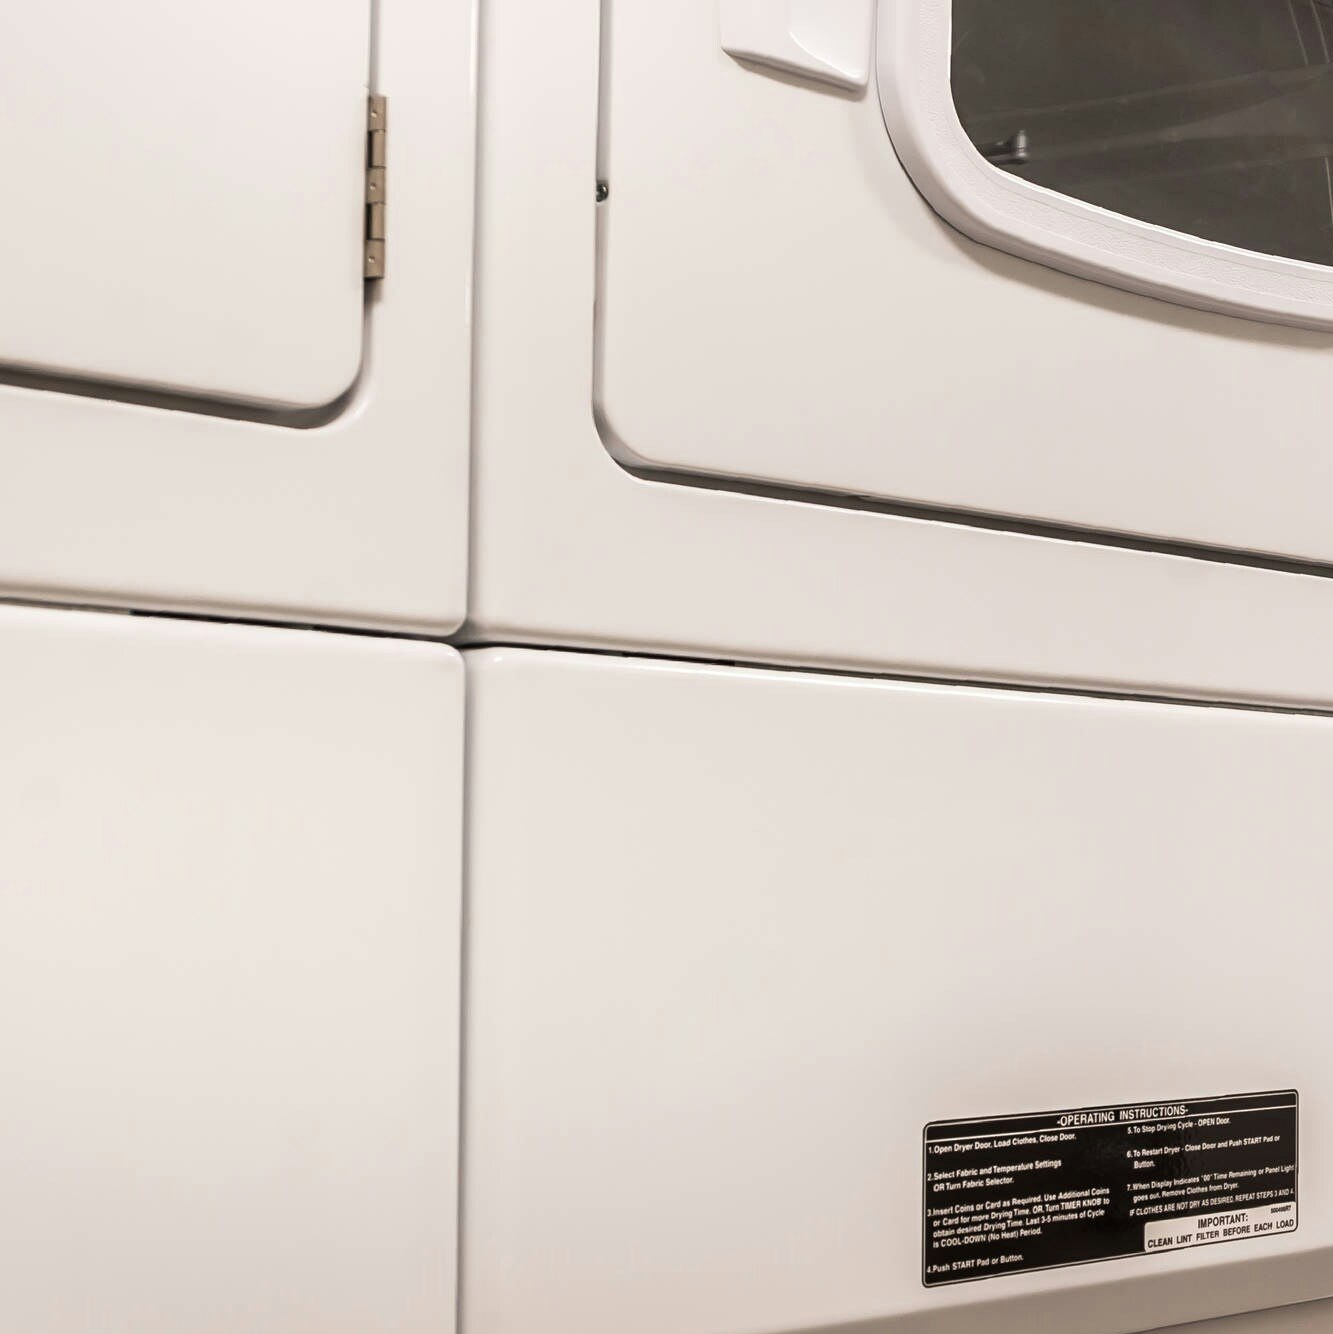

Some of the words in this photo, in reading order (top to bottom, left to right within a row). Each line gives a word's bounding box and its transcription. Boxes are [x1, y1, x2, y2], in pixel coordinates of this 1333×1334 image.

[1142, 1124, 1155, 1134] Stop
[1157, 1122, 1176, 1133] Drying
[1178, 1121, 1193, 1131] Cycle
[1198, 1119, 1214, 1127] OPEN
[954, 1142, 972, 1153] Dryer
[994, 1139, 1010, 1147] Load
[1040, 1134, 1058, 1143] Close
[1142, 1148, 1162, 1156] Restart
[1164, 1146, 1180, 1156] Dryer
[1185, 1144, 1201, 1152] Close
[1202, 1142, 1216, 1150] Door
[1229, 1139, 1242, 1147] Push
[1244, 1137, 1262, 1145] START
[957, 1168, 978, 1177] Fabric
[979, 1167, 992, 1175] and
[993, 1162, 1033, 1175] Temperature
[1035, 1159, 1061, 1171] Settings
[934, 1183, 945, 1192] OR
[946, 1182, 961, 1191] Turn
[963, 1179, 984, 1189] Fabric
[1151, 1179, 1172, 1190] Display
[1174, 1176, 1199, 1185] Indicates
[1229, 1169, 1256, 1180] Remaining
[1265, 1166, 1280, 1174] Panel
[955, 1203, 974, 1213] Coins
[985, 1200, 1001, 1209] Card
[1044, 1193, 1056, 1202] Use
[1058, 1189, 1090, 1200] Additional
[1091, 1187, 1110, 1196] Coins
[1133, 1195, 1148, 1203] goes
[1162, 1189, 1185, 1198] Remove
[1187, 1186, 1208, 1194] Clothes
[1209, 1184, 1223, 1192] from
[1136, 1205, 1162, 1216] CLOTHES
[1164, 1204, 1175, 1212] ARE
[1176, 1202, 1188, 1210] NOT
[1190, 1201, 1200, 1209] DRY
[1202, 1199, 1209, 1207] AS
[1235, 1193, 1255, 1202] REPEAT
[1256, 1191, 1273, 1200] STEPS
[1279, 1189, 1289, 1197] AND
[943, 1217, 959, 1225] Card
[960, 1215, 970, 1223] for
[971, 1214, 989, 1222] more
[991, 1210, 1012, 1221] Drying
[1045, 1204, 1060, 1212] Turn
[1061, 1201, 1081, 1210] TIMER
[1082, 1199, 1102, 1208] KNOB
[1198, 1213, 1248, 1229] IMPORTANT:
[933, 1228, 955, 1238] obtain
[957, 1224, 982, 1235] desired
[984, 1221, 1005, 1233] Drying
[1026, 1217, 1040, 1226] Last
[1041, 1215, 1051, 1224] 3-5
[1053, 1212, 1078, 1222] minutes
[1087, 1208, 1105, 1219] Cycle
[941, 1234, 986, 1248] COOL-DOWN
[988, 1232, 1000, 1242] (No
[1001, 1230, 1018, 1239] Heat)
[1148, 1237, 1173, 1248] CLEAN
[1176, 1234, 1192, 1244] LINT
[1196, 1230, 1219, 1241] FILTER
[1223, 1225, 1250, 1237] BEFORE
[1254, 1222, 1272, 1232] EACH
[1276, 1219, 1294, 1229] LOAD
[952, 1260, 975, 1270] START
[977, 1258, 990, 1267] Pad
